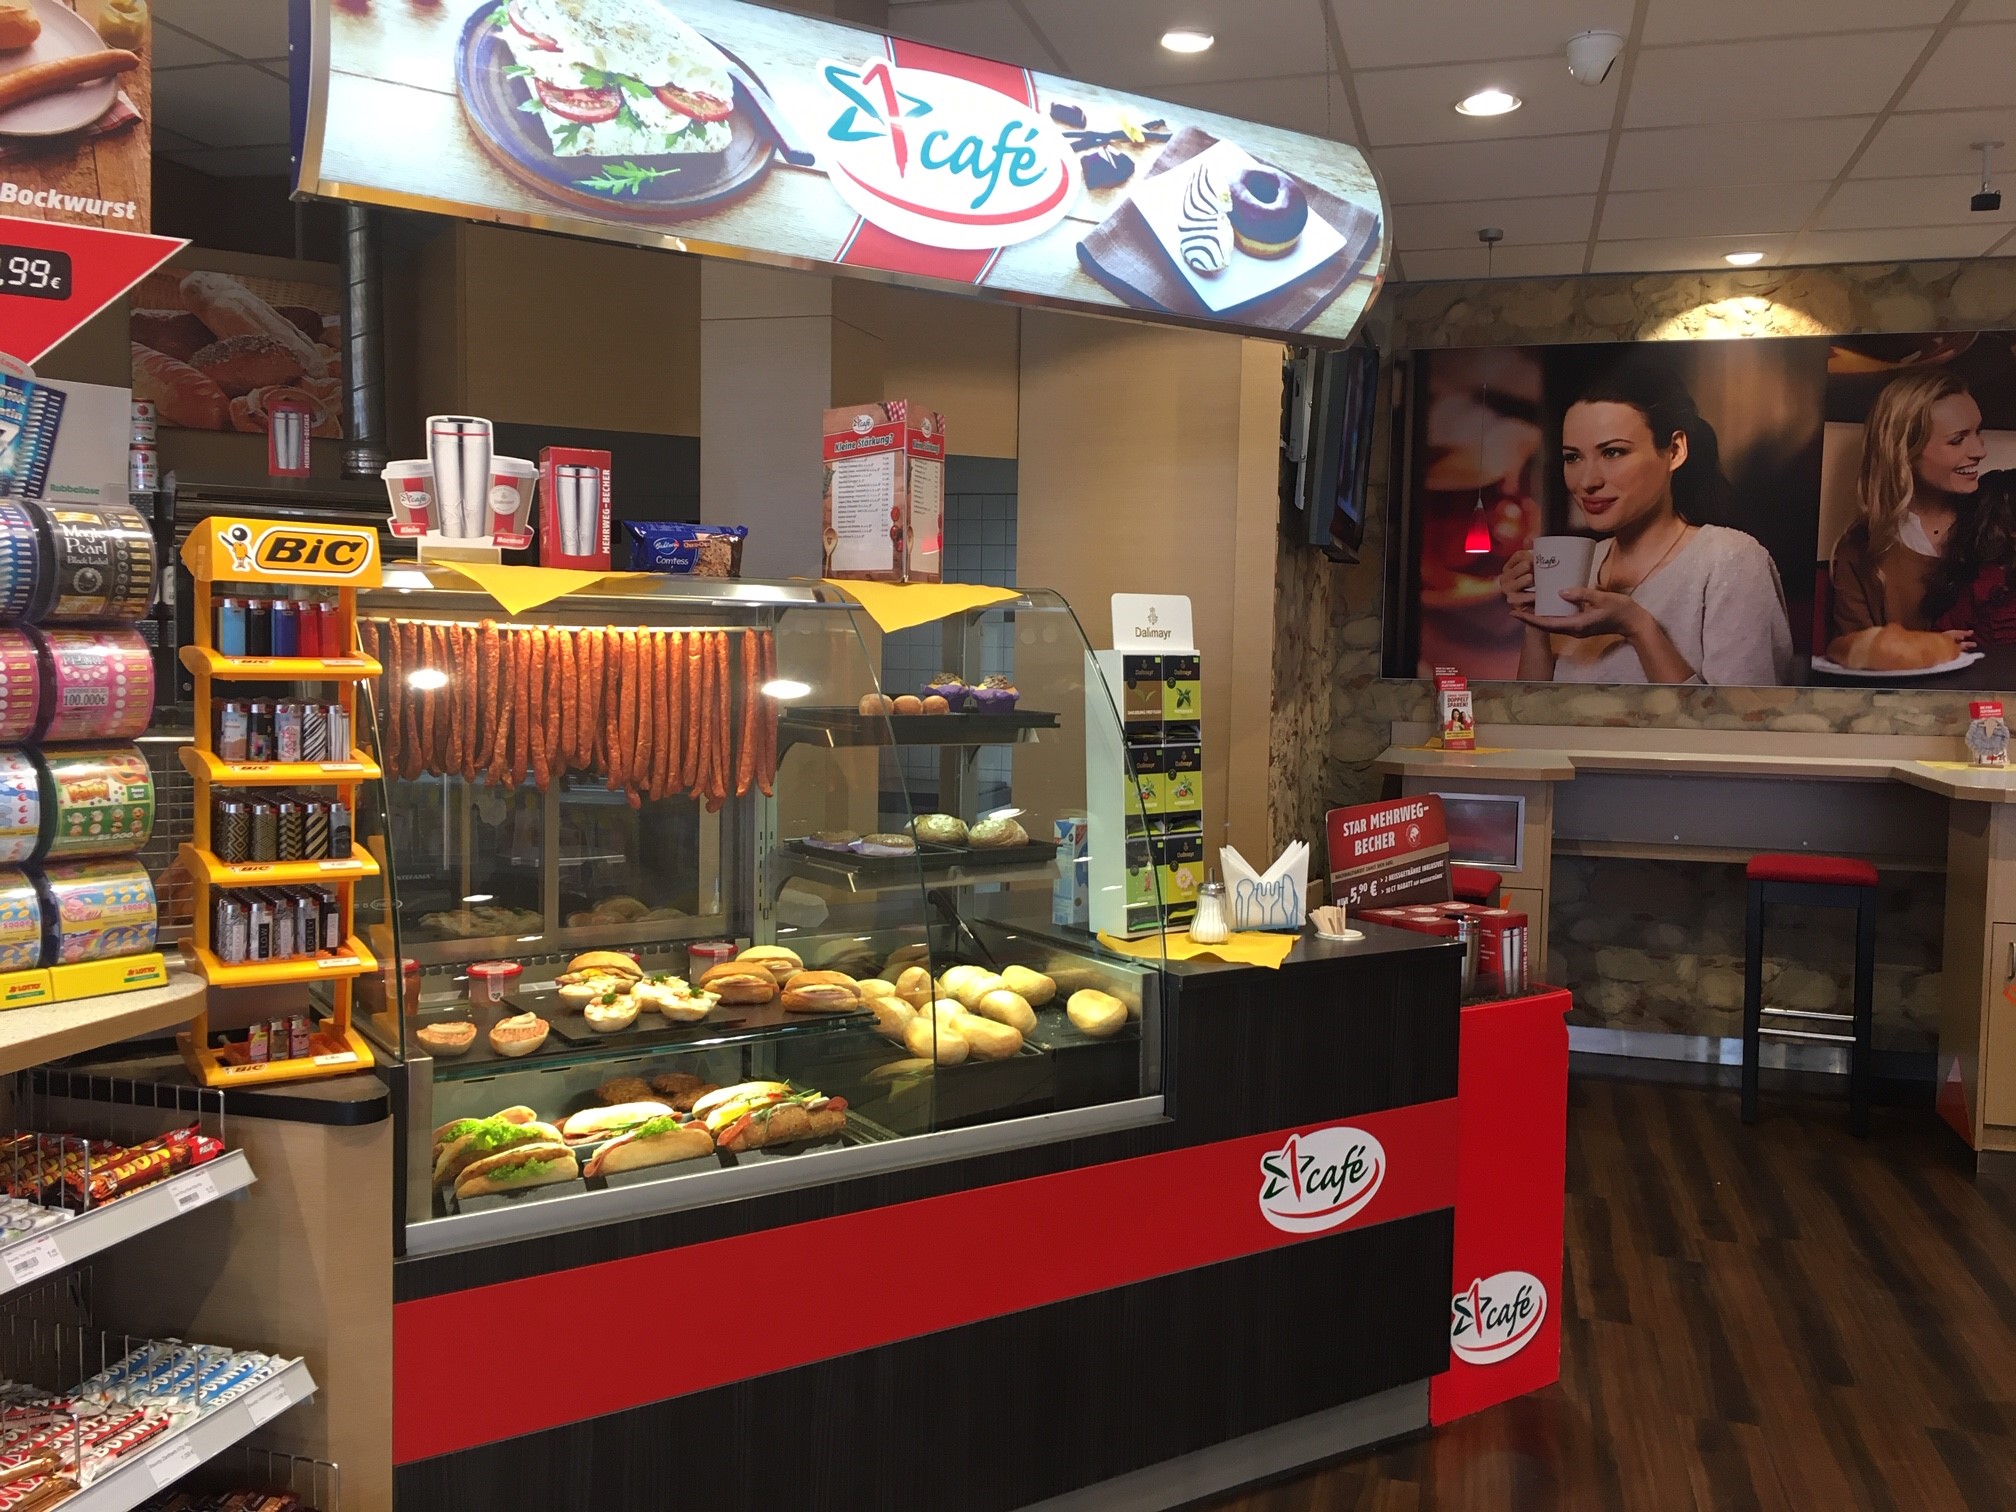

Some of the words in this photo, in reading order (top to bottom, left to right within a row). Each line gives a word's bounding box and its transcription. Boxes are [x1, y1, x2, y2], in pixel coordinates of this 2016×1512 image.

[919, 119, 1047, 210] café
[0, 182, 137, 220] Bockwurst
[834, 440, 856, 453] Kleine
[857, 432, 894, 449] Stärkung?
[602, 469, 611, 554] MEHRWEG-BECHER
[400, 526, 421, 534] Klein
[496, 537, 525, 545] Normal
[64, 537, 108, 555] Pearl
[264, 537, 363, 566] BiC
[656, 556, 689, 565] Comtess
[1135, 626, 1171, 640] Dallmayr
[64, 694, 106, 706] 100.000€
[1343, 818, 1367, 837] STAR
[1370, 802, 1430, 830] MEHRWEG-
[1354, 831, 1395, 856] BECHER
[1370, 880, 1378, 897] €
[260, 928, 268, 955] FLOW
[307, 920, 315, 952] SOFTLY
[135, 966, 156, 975] LOTTO
[18, 983, 40, 991] LOTTO
[115, 1149, 170, 1181] LION
[1306, 1145, 1369, 1204] café
[1486, 1285, 1534, 1337] café
[90, 1412, 168, 1457] BOUNTY
